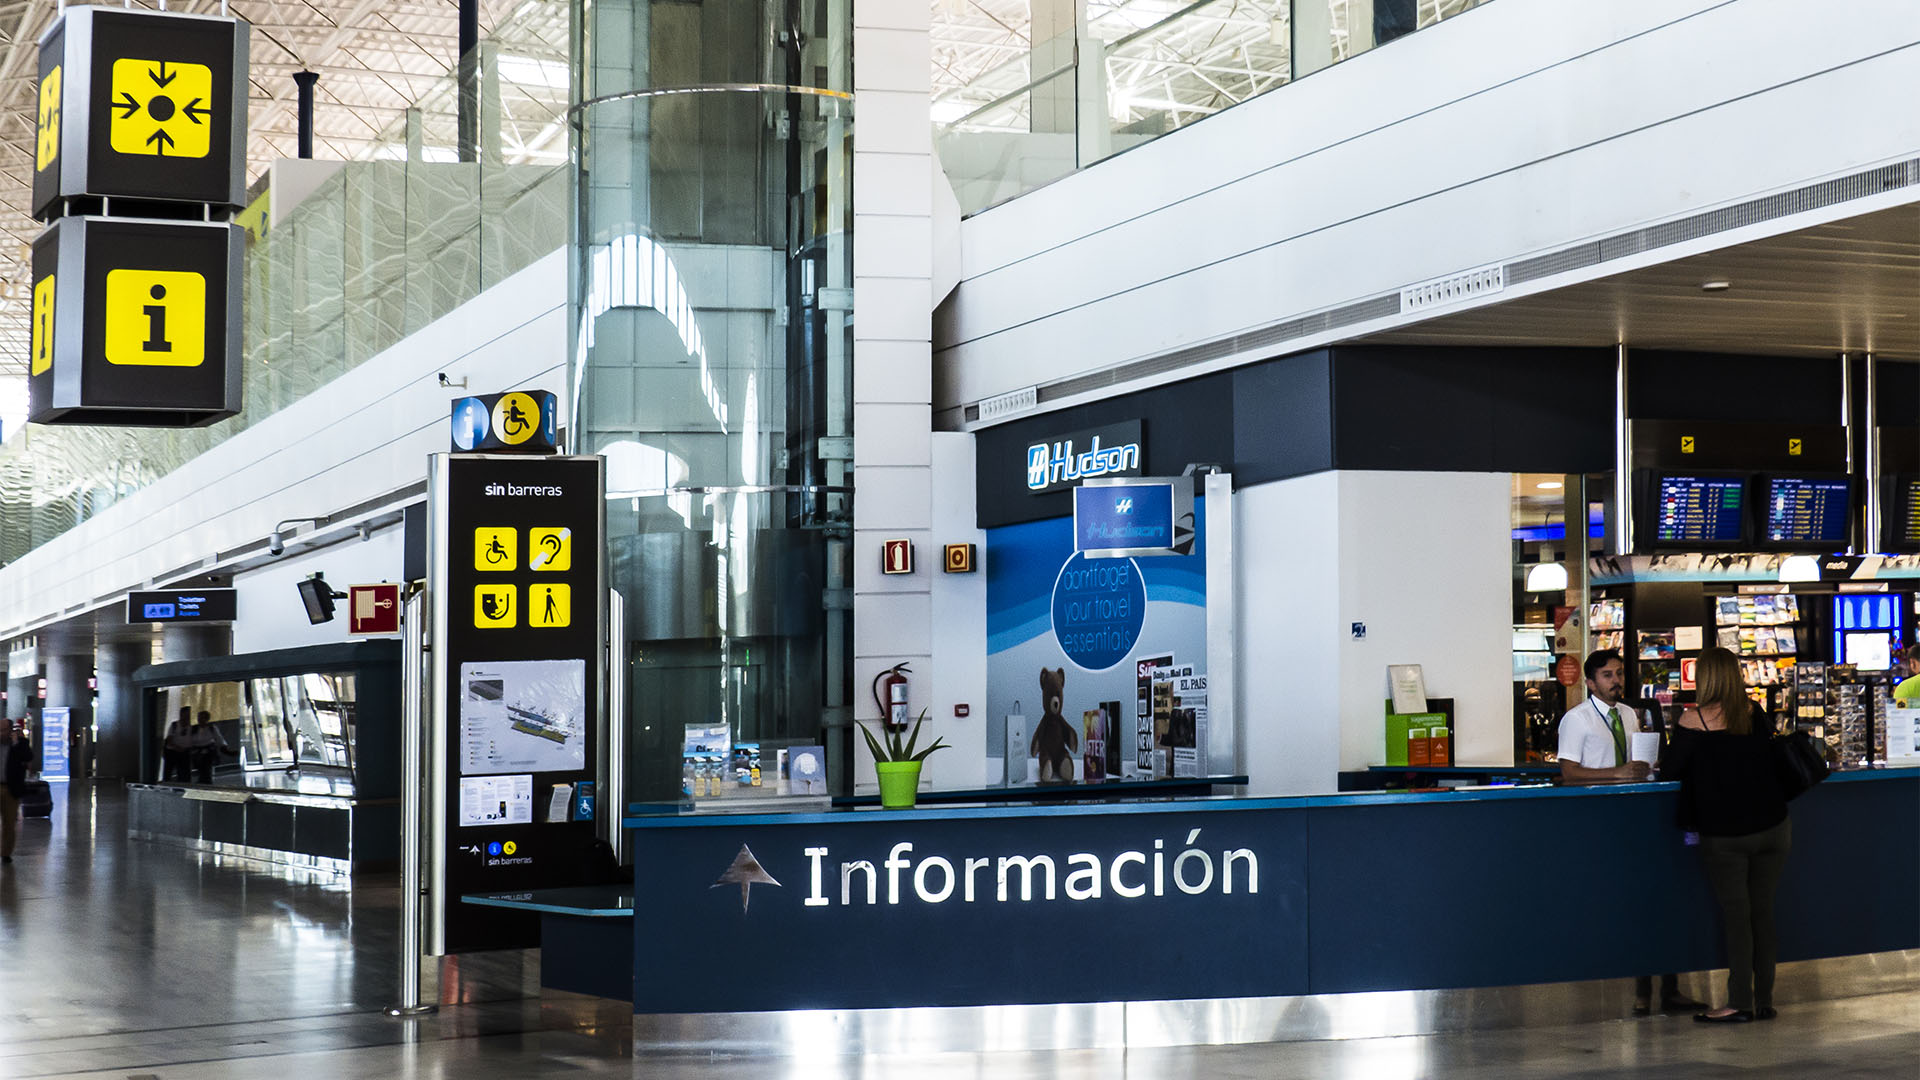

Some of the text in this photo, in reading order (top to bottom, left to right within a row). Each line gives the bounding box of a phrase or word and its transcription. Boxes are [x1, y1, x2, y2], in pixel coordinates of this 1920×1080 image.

[1050, 435, 1140, 484] Hudson
[485, 482, 563, 497] sin barreras
[1064, 592, 1131, 624] your travel
[1064, 626, 1131, 653] essentials
[1181, 676, 1207, 690] EL PAÍS
[488, 857, 533, 866] sin barreras
[804, 828, 1259, 906] Información
